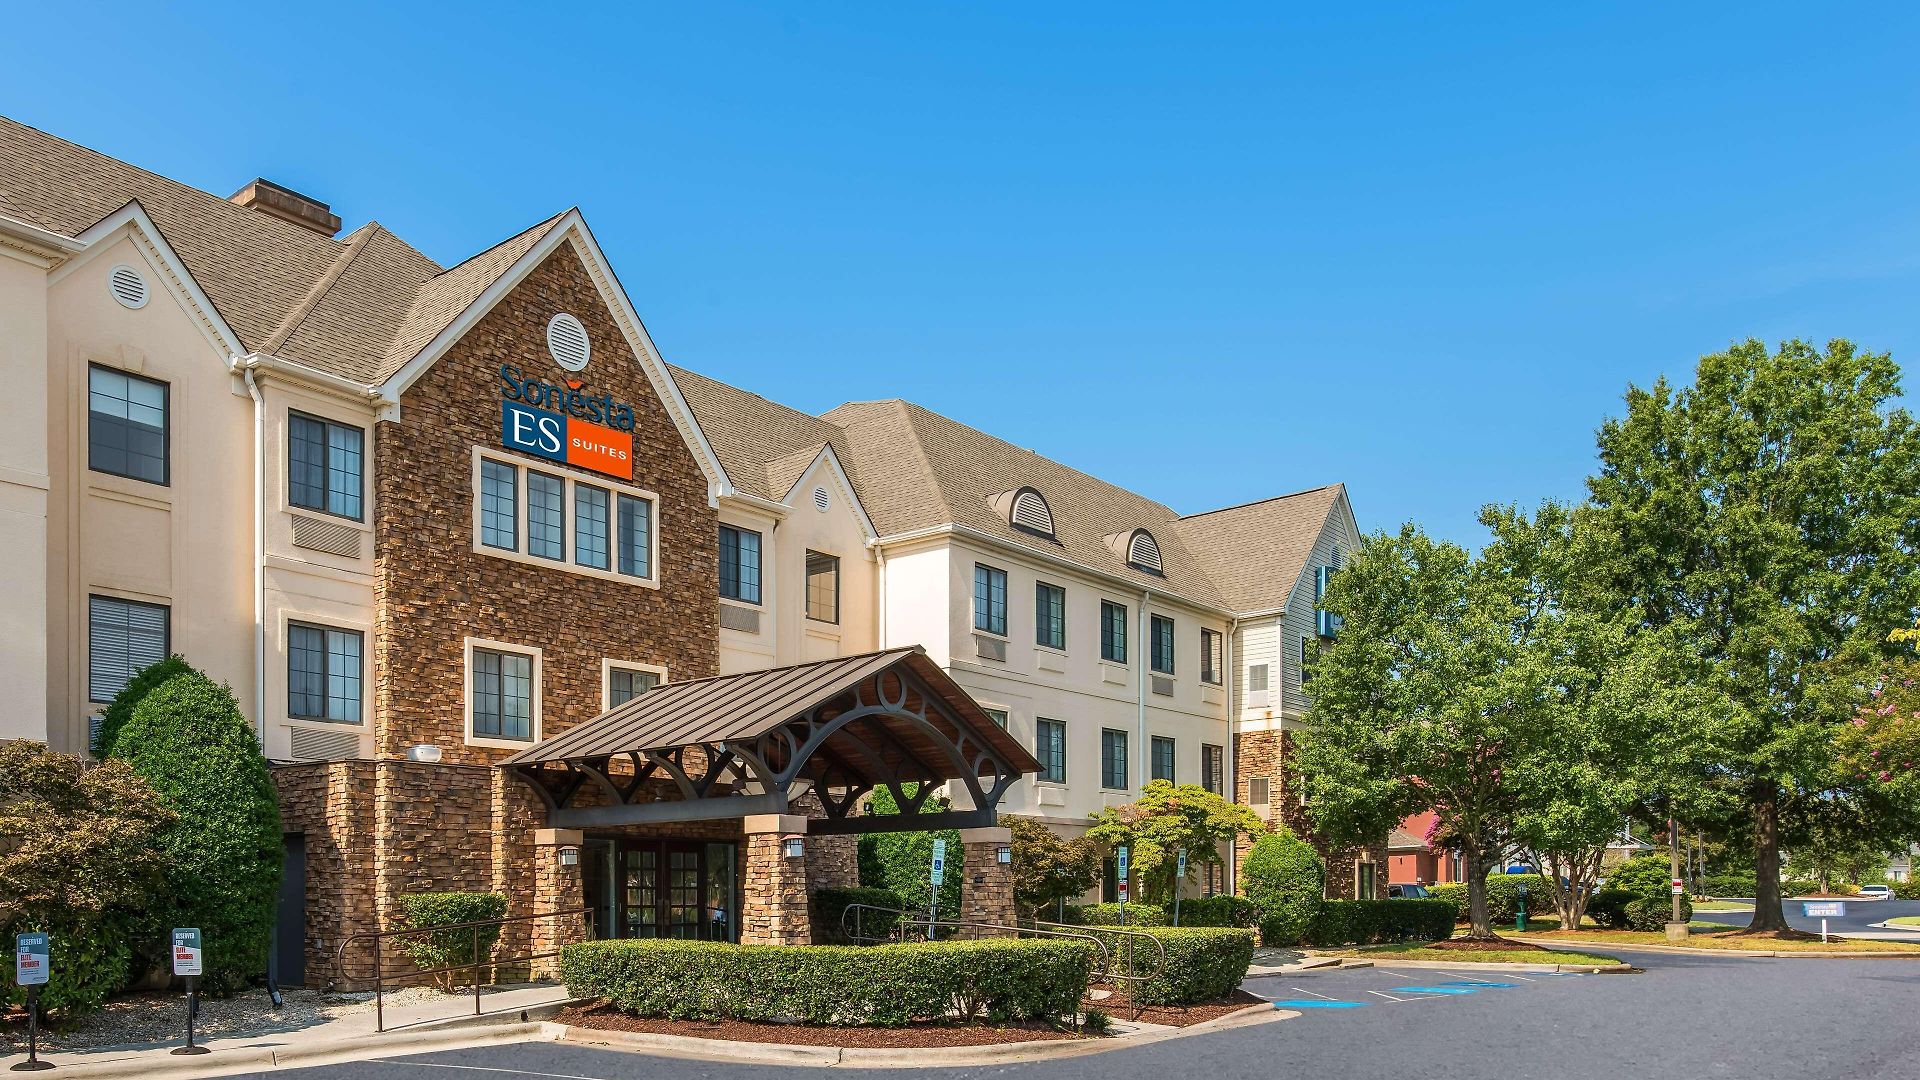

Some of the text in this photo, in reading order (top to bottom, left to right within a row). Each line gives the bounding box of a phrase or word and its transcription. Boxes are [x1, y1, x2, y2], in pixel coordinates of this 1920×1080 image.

[501, 364, 635, 432] Sonesta
[510, 408, 627, 460] ES SUITES
